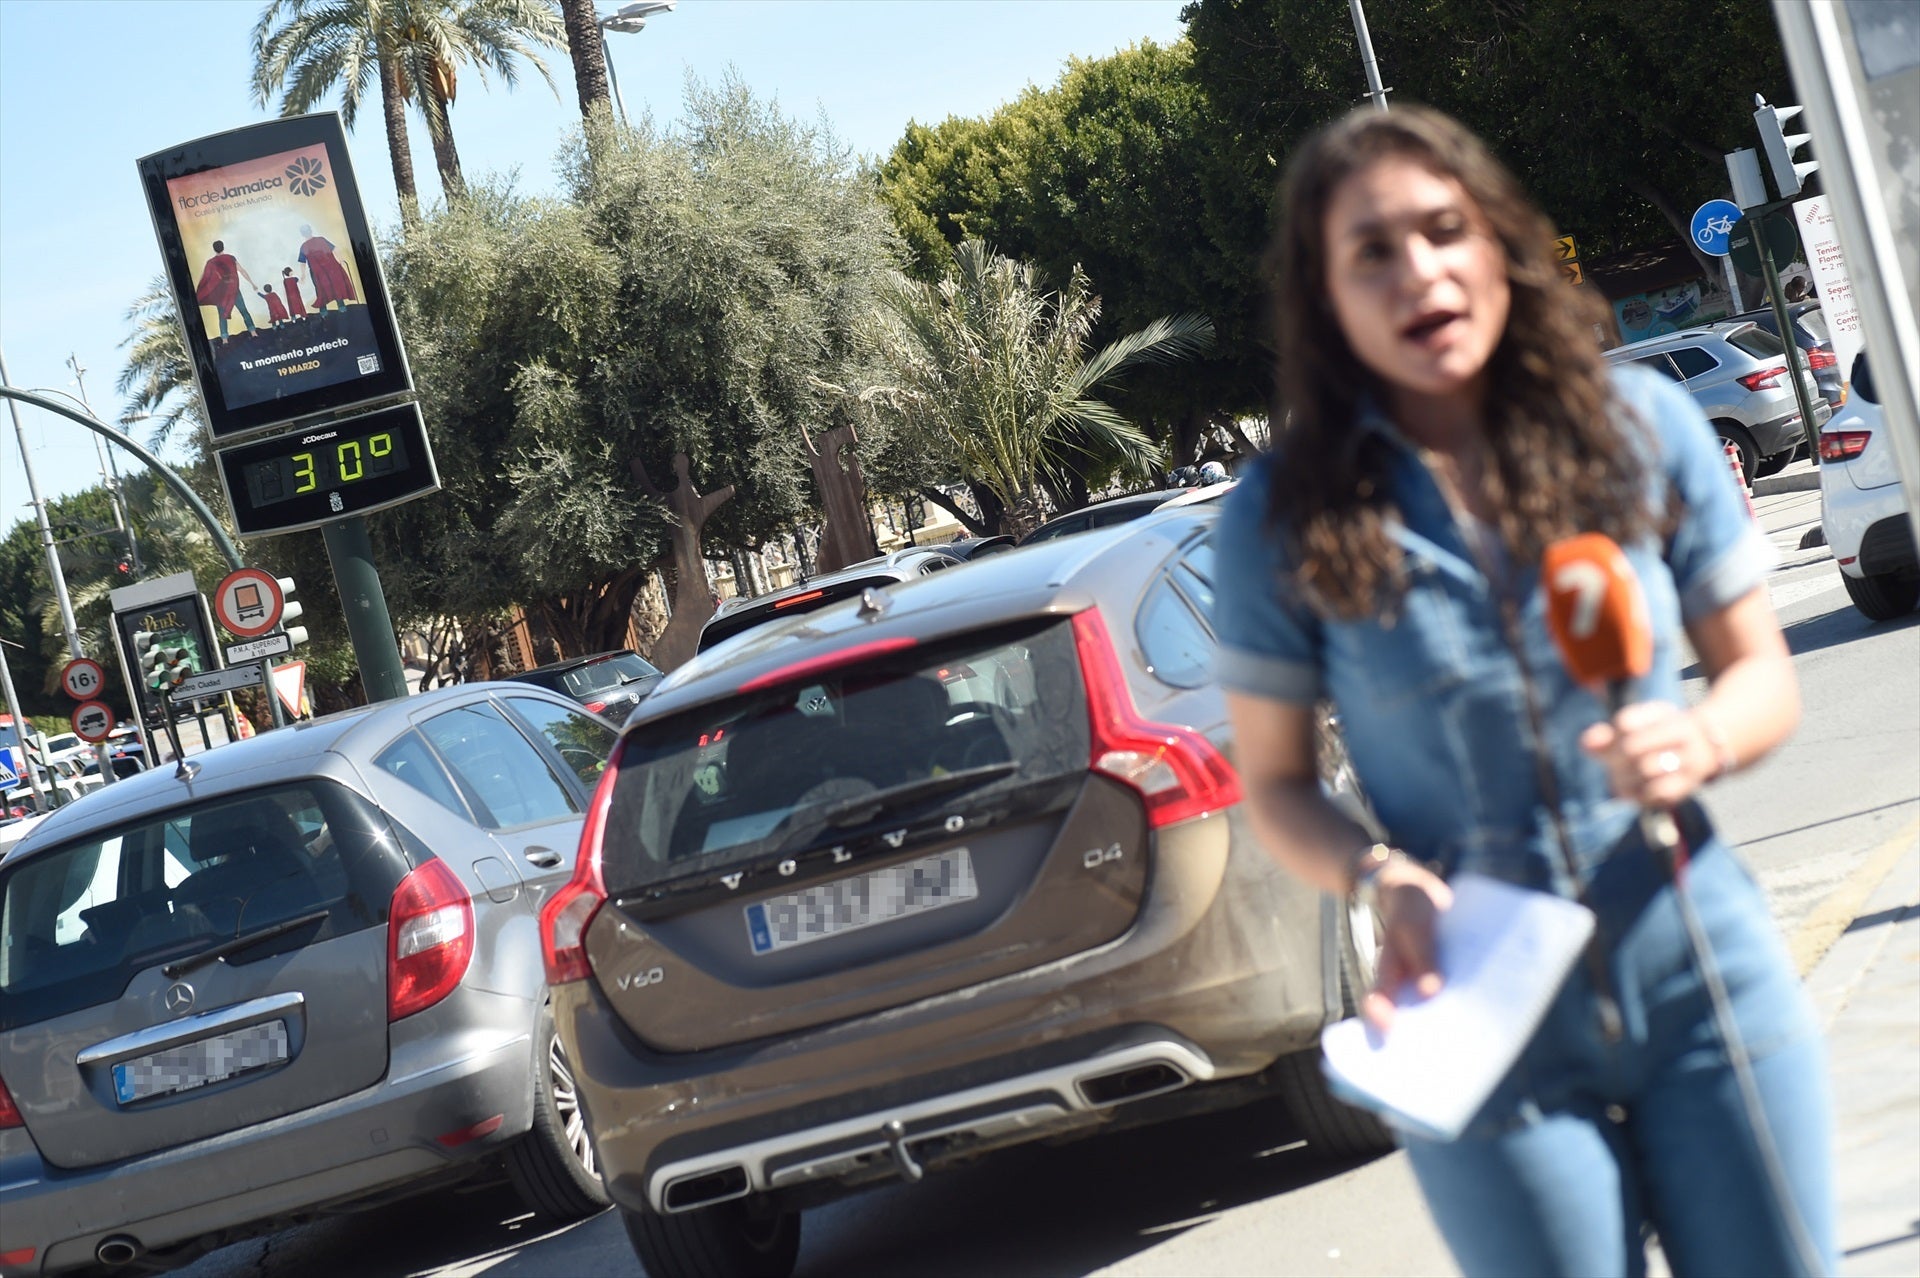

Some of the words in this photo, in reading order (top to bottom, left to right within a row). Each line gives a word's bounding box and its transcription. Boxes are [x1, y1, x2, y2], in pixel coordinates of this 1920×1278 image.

[240, 361, 253, 371] Tu
[255, 349, 304, 368] momento
[306, 338, 349, 357] perfecto
[277, 367, 287, 377] 19
[288, 360, 320, 375] MARZO
[301, 431, 338, 445] JCDecaux
[252, 638, 281, 650] SUPERIOR
[198, 679, 221, 690] Ciudad
[720, 815, 965, 890] VOLVO
[1083, 842, 1122, 868] D4
[616, 967, 664, 991] V60
